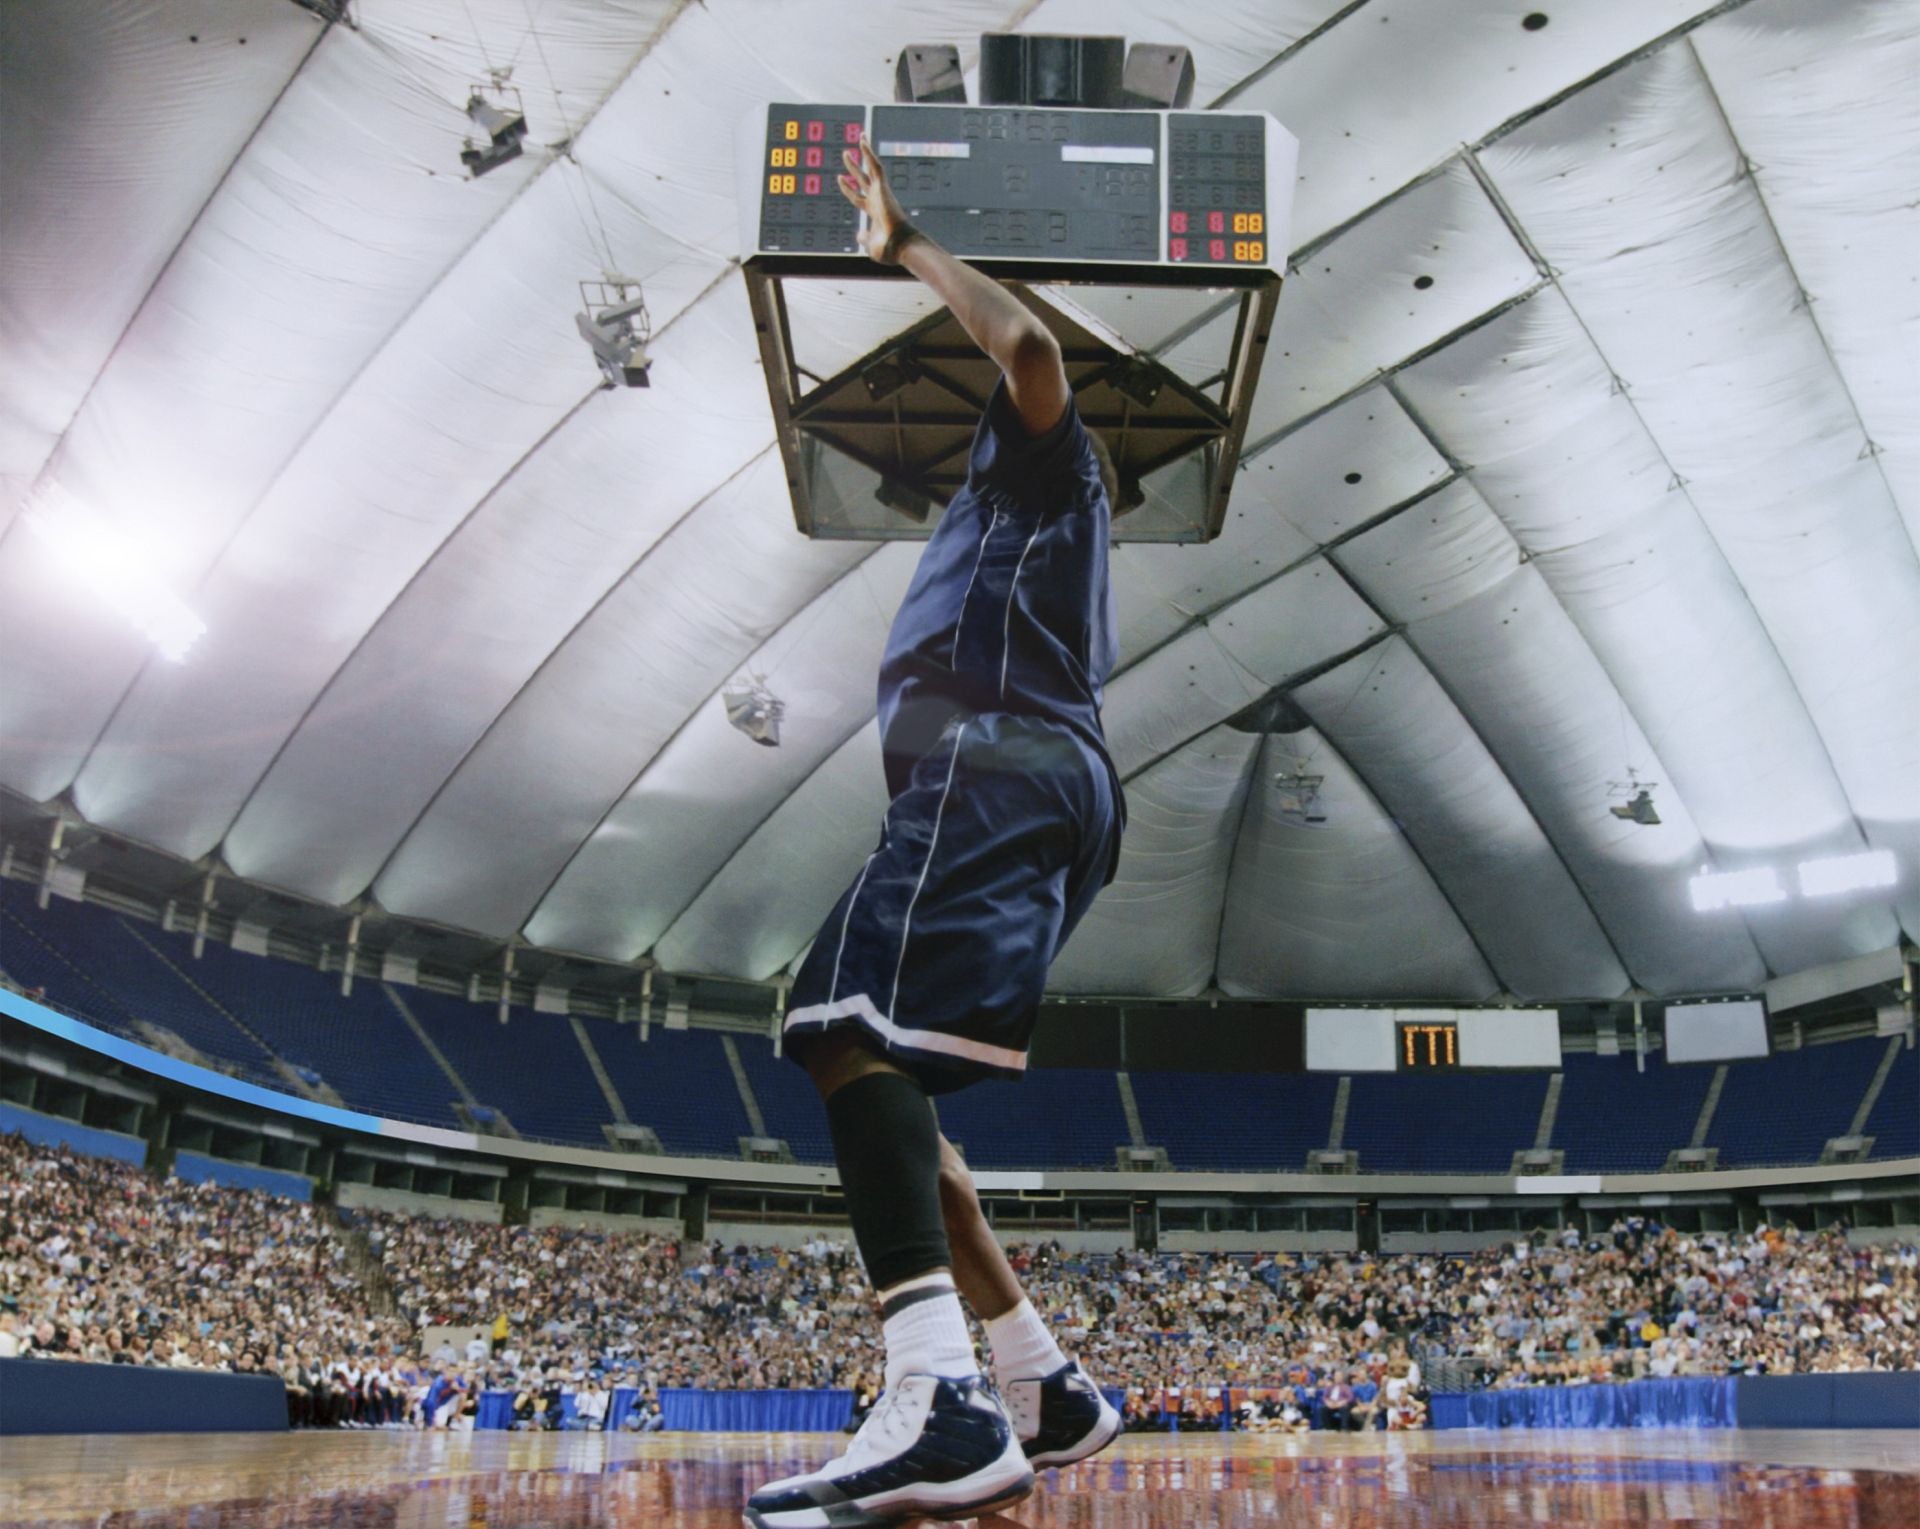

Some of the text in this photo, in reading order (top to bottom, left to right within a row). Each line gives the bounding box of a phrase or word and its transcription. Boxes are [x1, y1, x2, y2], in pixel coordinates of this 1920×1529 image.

[771, 148, 798, 168] 88
[769, 174, 796, 194] 88
[1233, 213, 1263, 233] 88
[1233, 241, 1263, 261] 88
